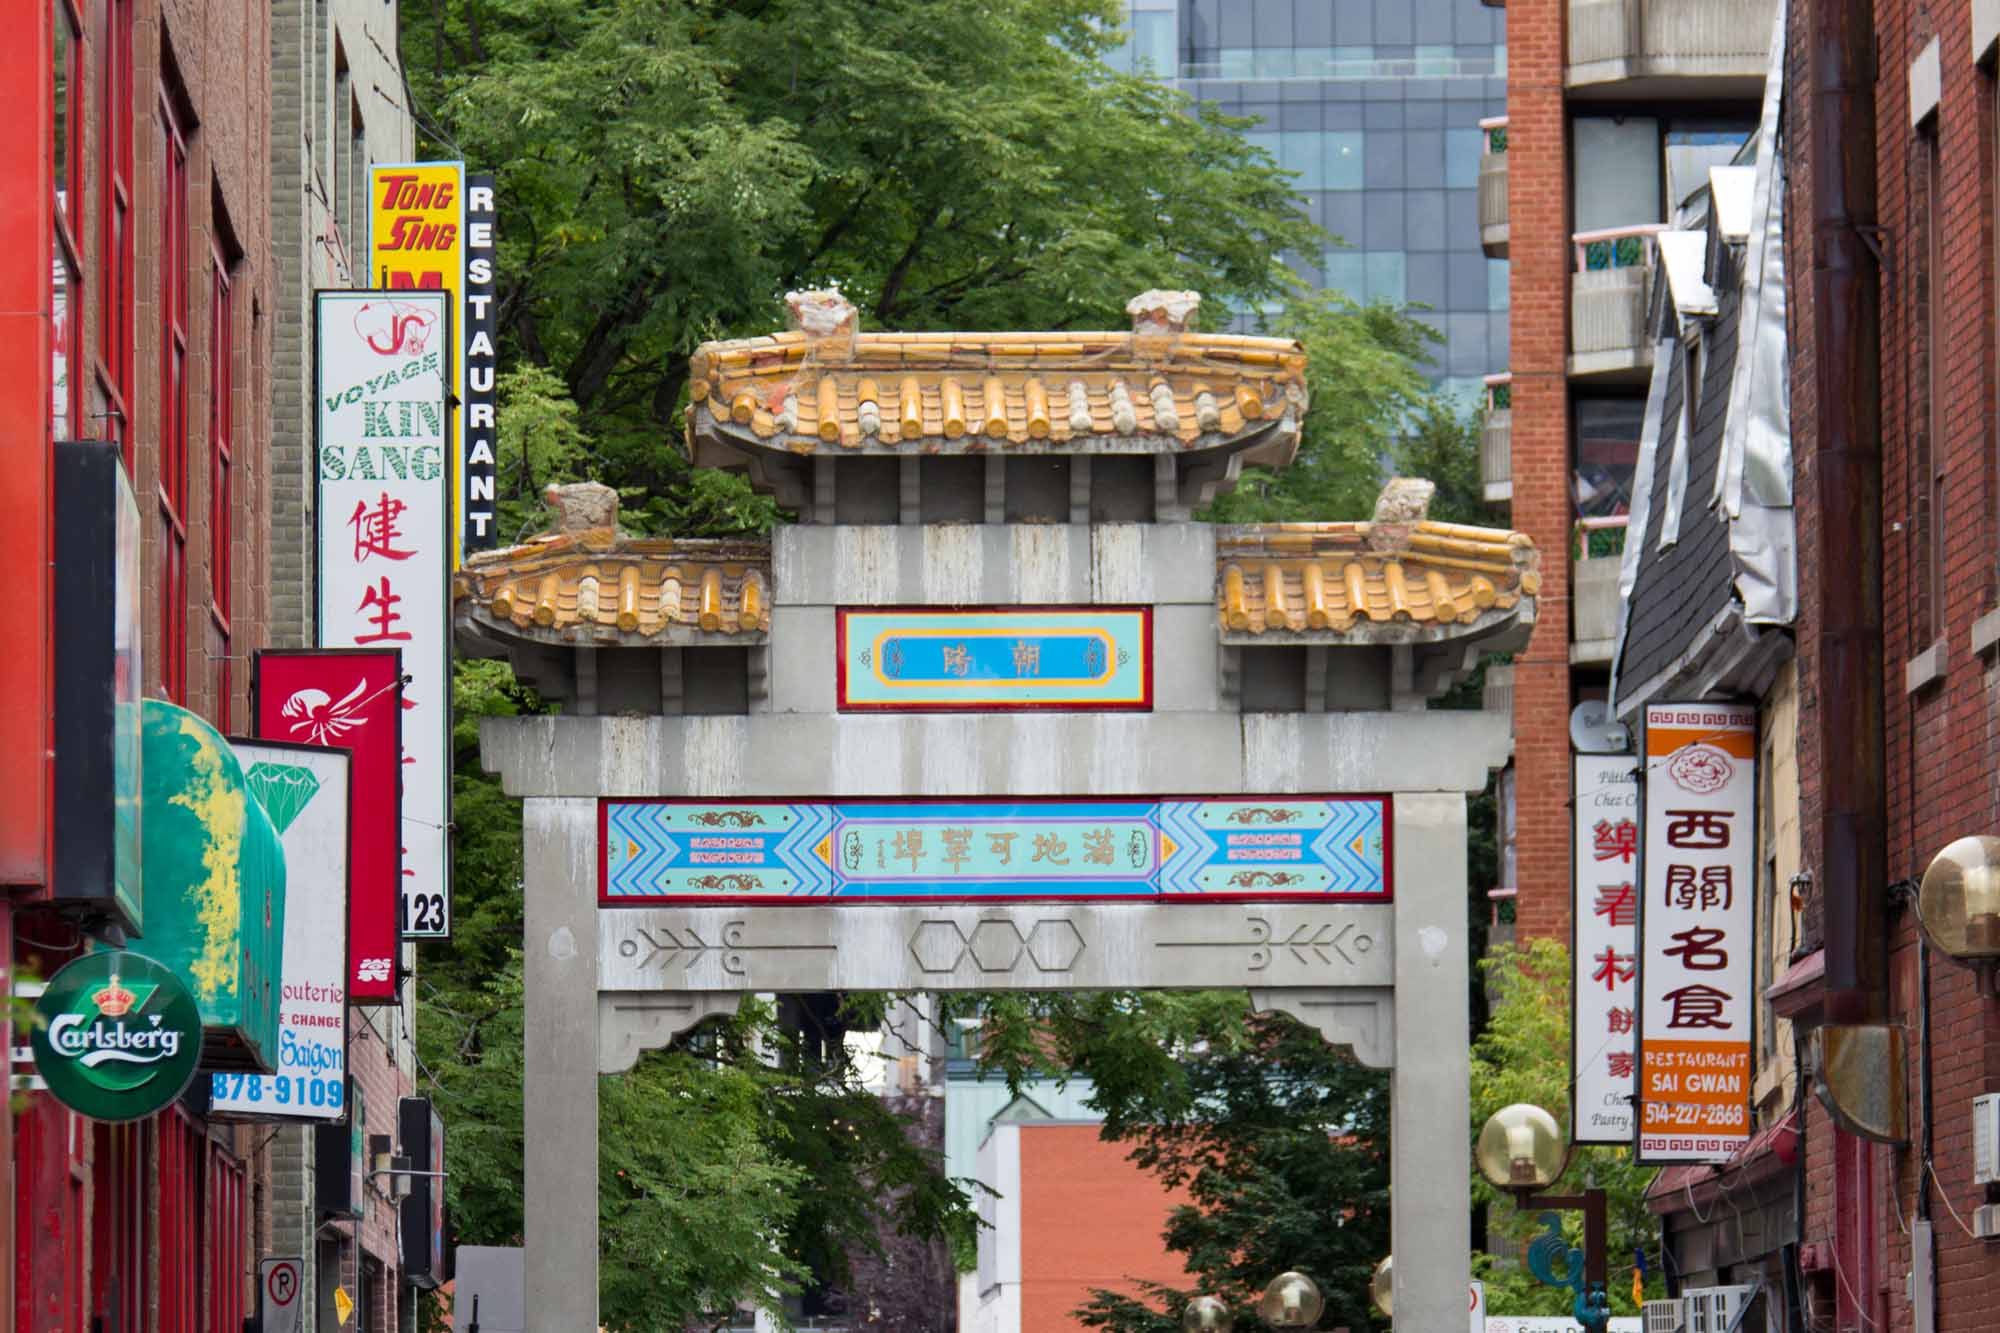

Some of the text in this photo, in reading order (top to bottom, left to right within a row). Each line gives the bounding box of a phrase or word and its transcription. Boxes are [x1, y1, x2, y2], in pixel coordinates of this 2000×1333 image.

[379, 175, 454, 210] TONG
[377, 216, 457, 251] SING
[468, 186, 495, 538] RESTAURANT
[325, 352, 439, 413] VOYAGE
[361, 400, 443, 438] KIN
[320, 444, 442, 481] SANG
[281, 980, 344, 1004] outerie
[48, 1013, 179, 1065] Carlsberg
[292, 1013, 342, 1029] CHANGE
[280, 1029, 343, 1076] Saigon
[1644, 1051, 1748, 1068] RESTAURANT
[212, 1071, 344, 1109] 878-9109
[1651, 1072, 1741, 1094] SAI GWAN
[1645, 1102, 1745, 1126] 514-227-2868
